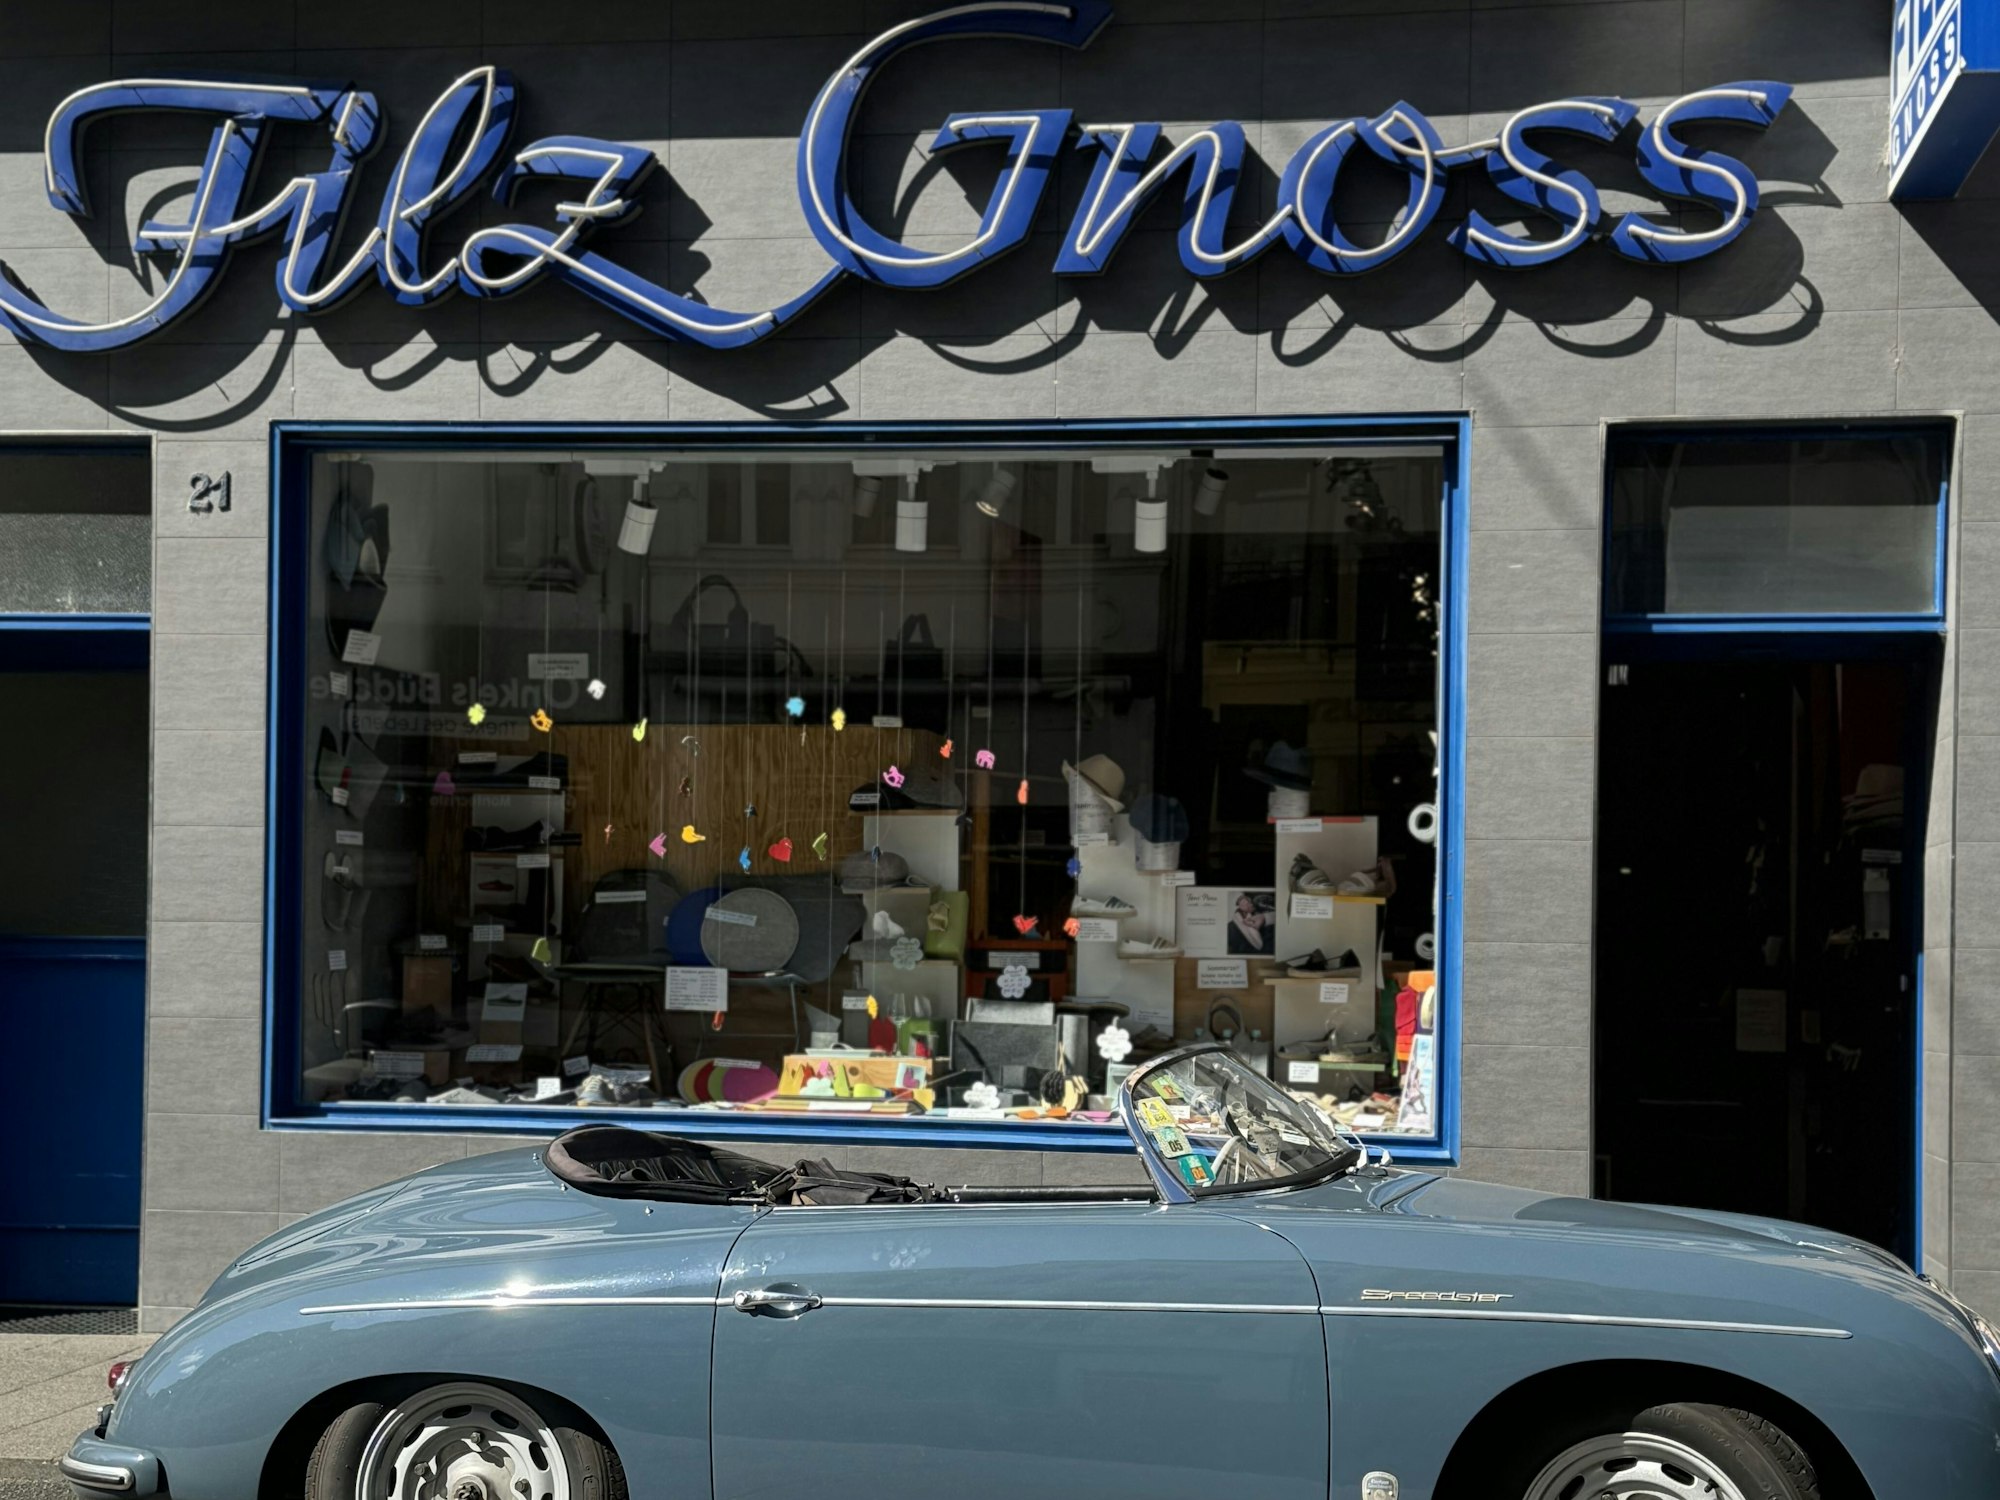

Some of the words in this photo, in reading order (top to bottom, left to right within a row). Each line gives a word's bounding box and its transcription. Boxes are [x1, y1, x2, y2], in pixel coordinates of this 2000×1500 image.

[1891, 21, 1956, 166] GNOSS
[0, 65, 838, 352] Filz
[798, 0, 1795, 291] Gnoss
[187, 470, 232, 514] 21
[1168, 1140, 1184, 1152] 05
[1360, 1288, 1514, 1302] Speedster
